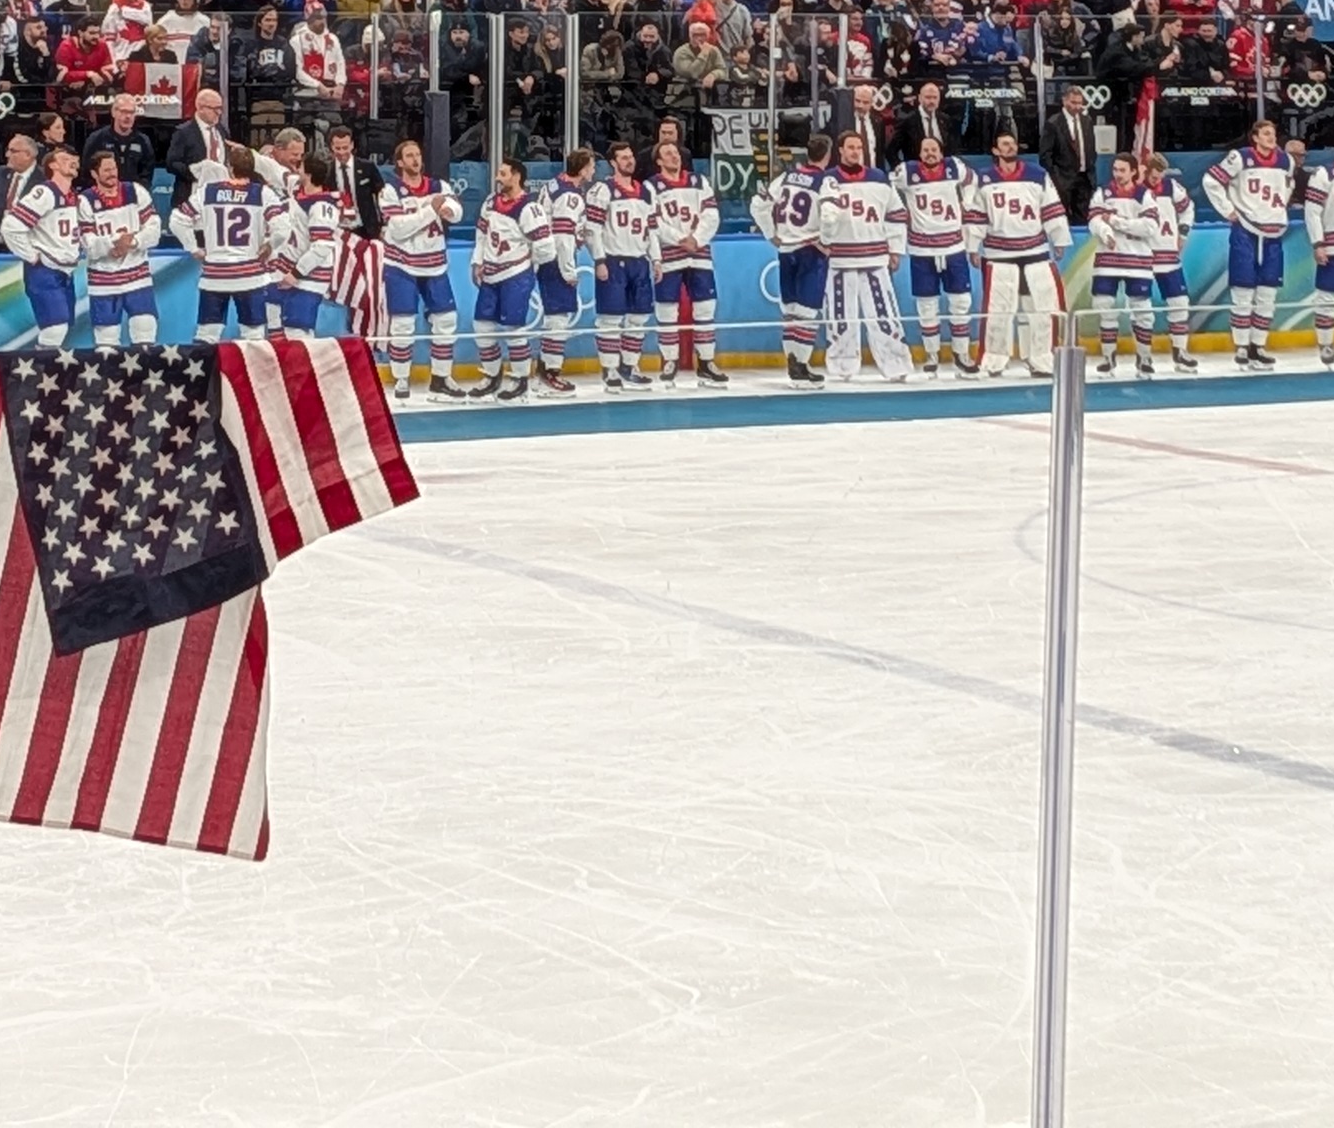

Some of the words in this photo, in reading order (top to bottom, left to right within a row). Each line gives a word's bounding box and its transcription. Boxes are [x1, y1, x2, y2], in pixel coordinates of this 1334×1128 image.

[83, 95, 116, 106] MILA
[772, 187, 813, 227] 29
[915, 194, 957, 221] USA
[992, 192, 1037, 221] USA
[1247, 178, 1285, 208] USA
[838, 193, 879, 223] USA
[213, 207, 252, 247] 12
[490, 232, 511, 256] SA
